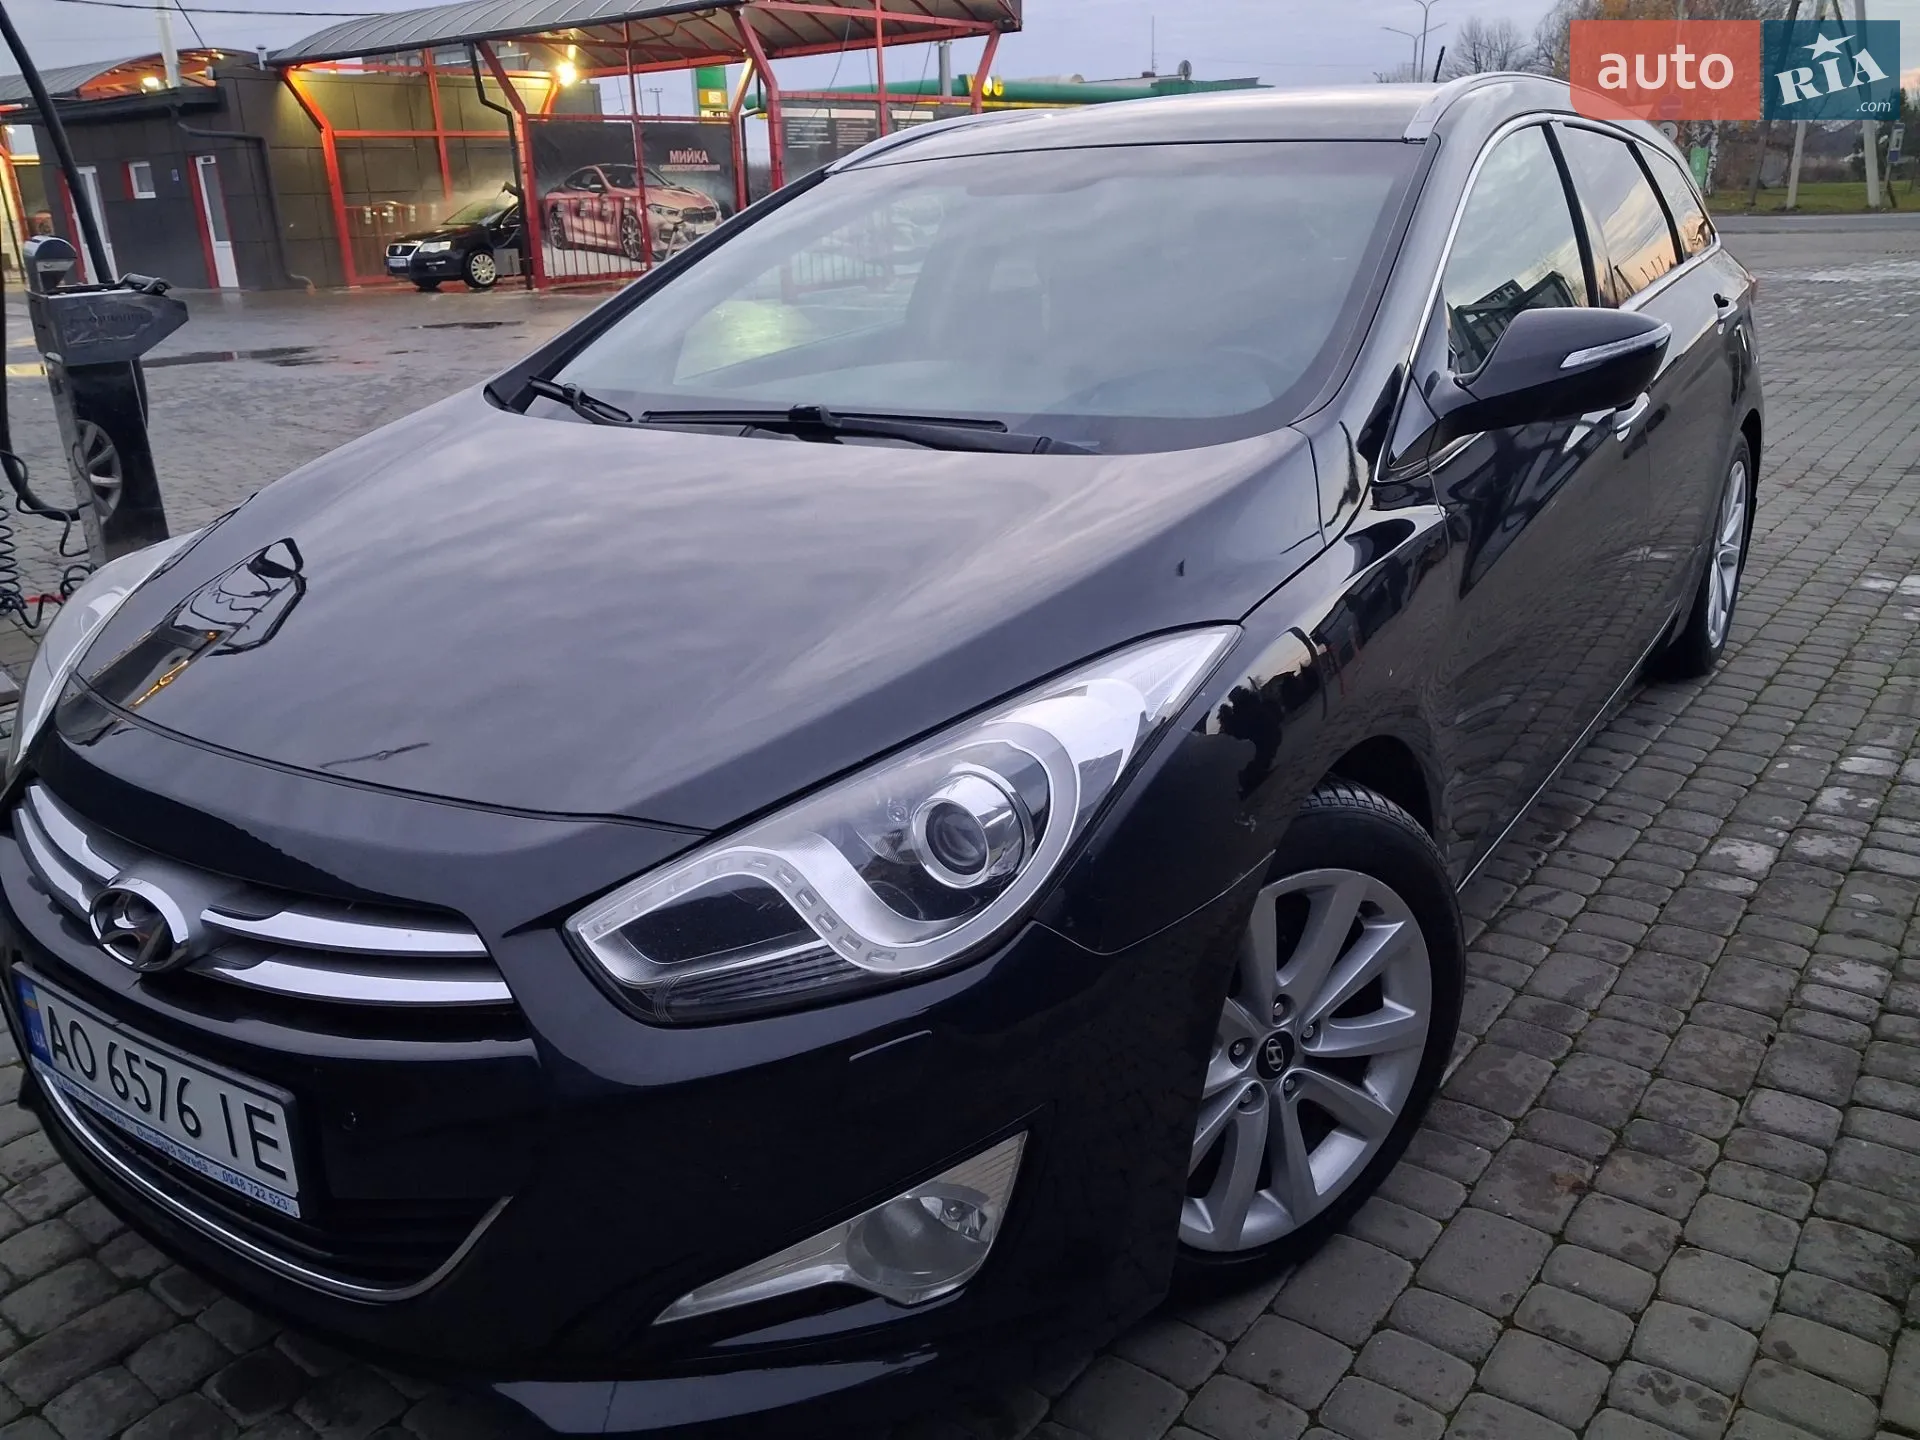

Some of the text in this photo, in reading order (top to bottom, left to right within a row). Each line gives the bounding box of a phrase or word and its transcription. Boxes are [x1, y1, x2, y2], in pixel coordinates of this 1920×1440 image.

[669, 147, 709, 164] МИЙКА
[47, 1005, 97, 1081] AO
[107, 1040, 202, 1138] 6576
[219, 1092, 287, 1181] IE
